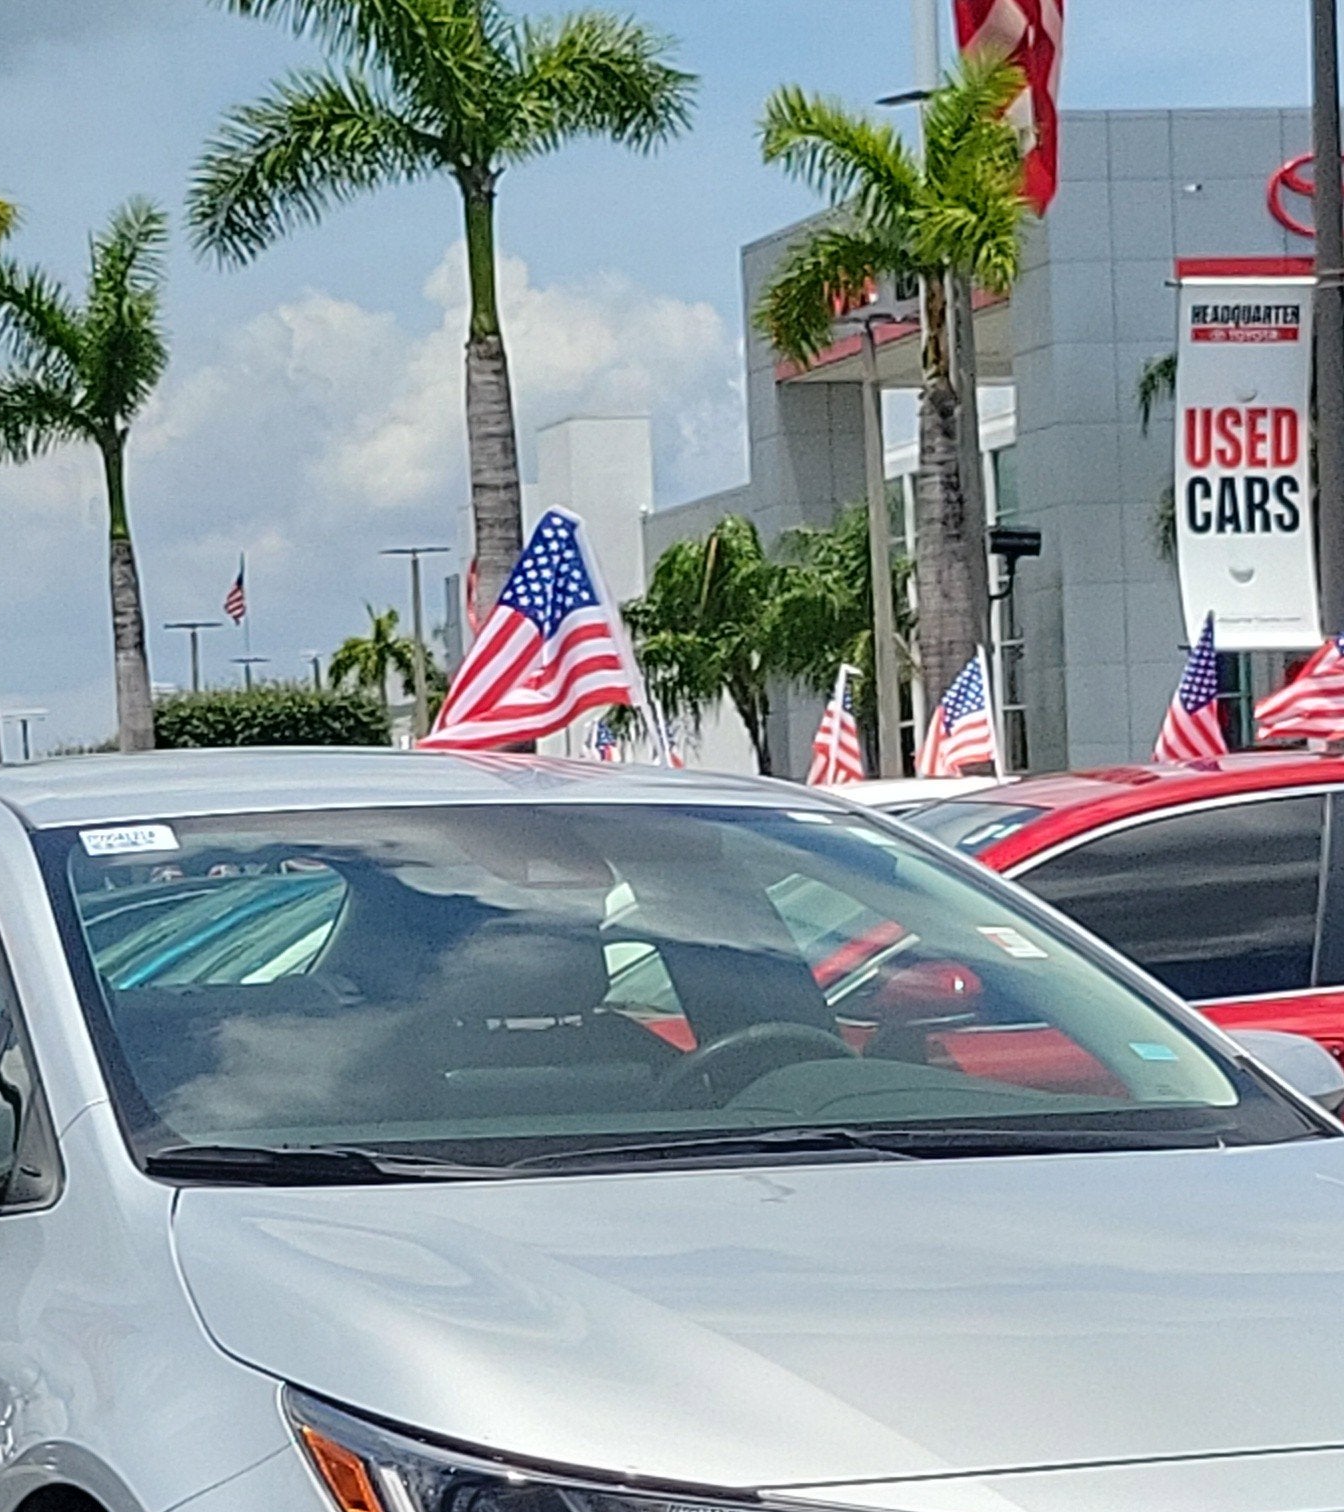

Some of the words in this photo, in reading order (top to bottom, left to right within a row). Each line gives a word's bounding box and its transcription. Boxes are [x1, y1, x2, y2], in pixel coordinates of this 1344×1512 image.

[1191, 304, 1300, 328] HEADQUARTER
[1184, 405, 1299, 470] USED
[1185, 475, 1301, 534] CARS
